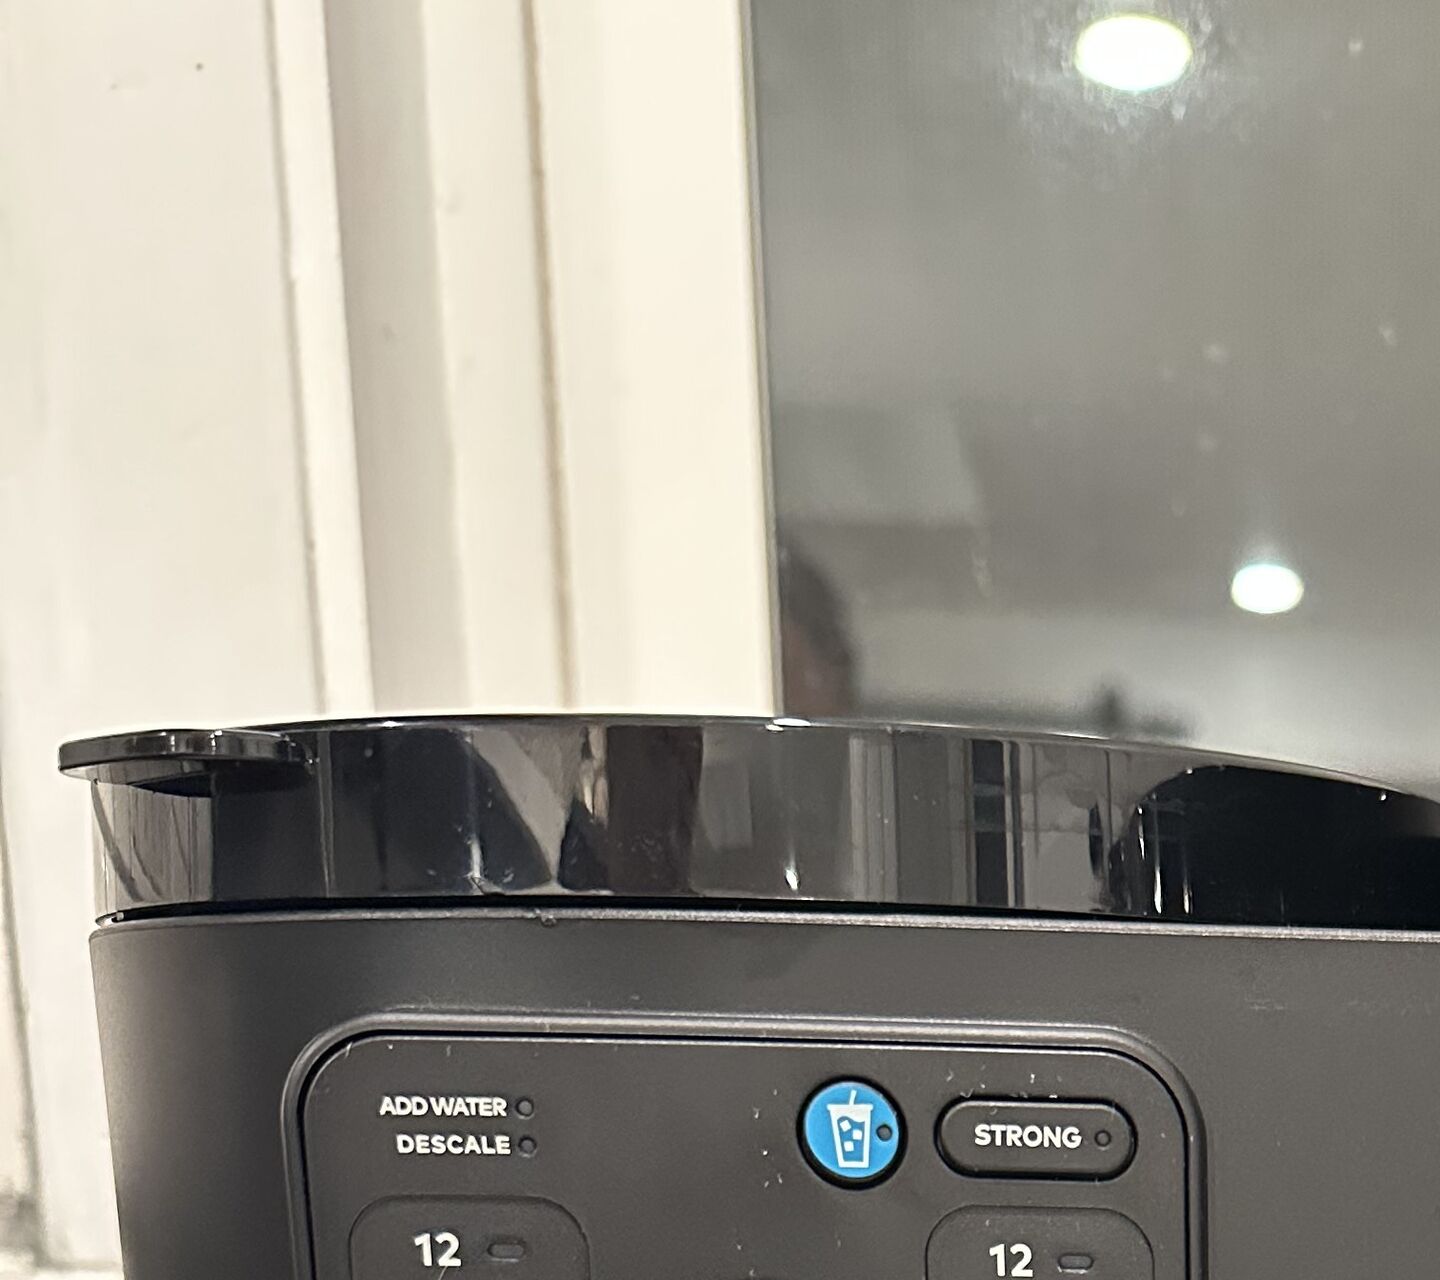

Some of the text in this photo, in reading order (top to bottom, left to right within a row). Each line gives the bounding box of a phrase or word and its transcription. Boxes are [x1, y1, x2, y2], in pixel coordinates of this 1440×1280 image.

[380, 1095, 508, 1117] ADD WATER
[396, 1133, 511, 1155] DESCALE
[974, 1124, 1083, 1150] STRONG
[414, 1231, 462, 1268] 12
[988, 1243, 1034, 1278] 12
